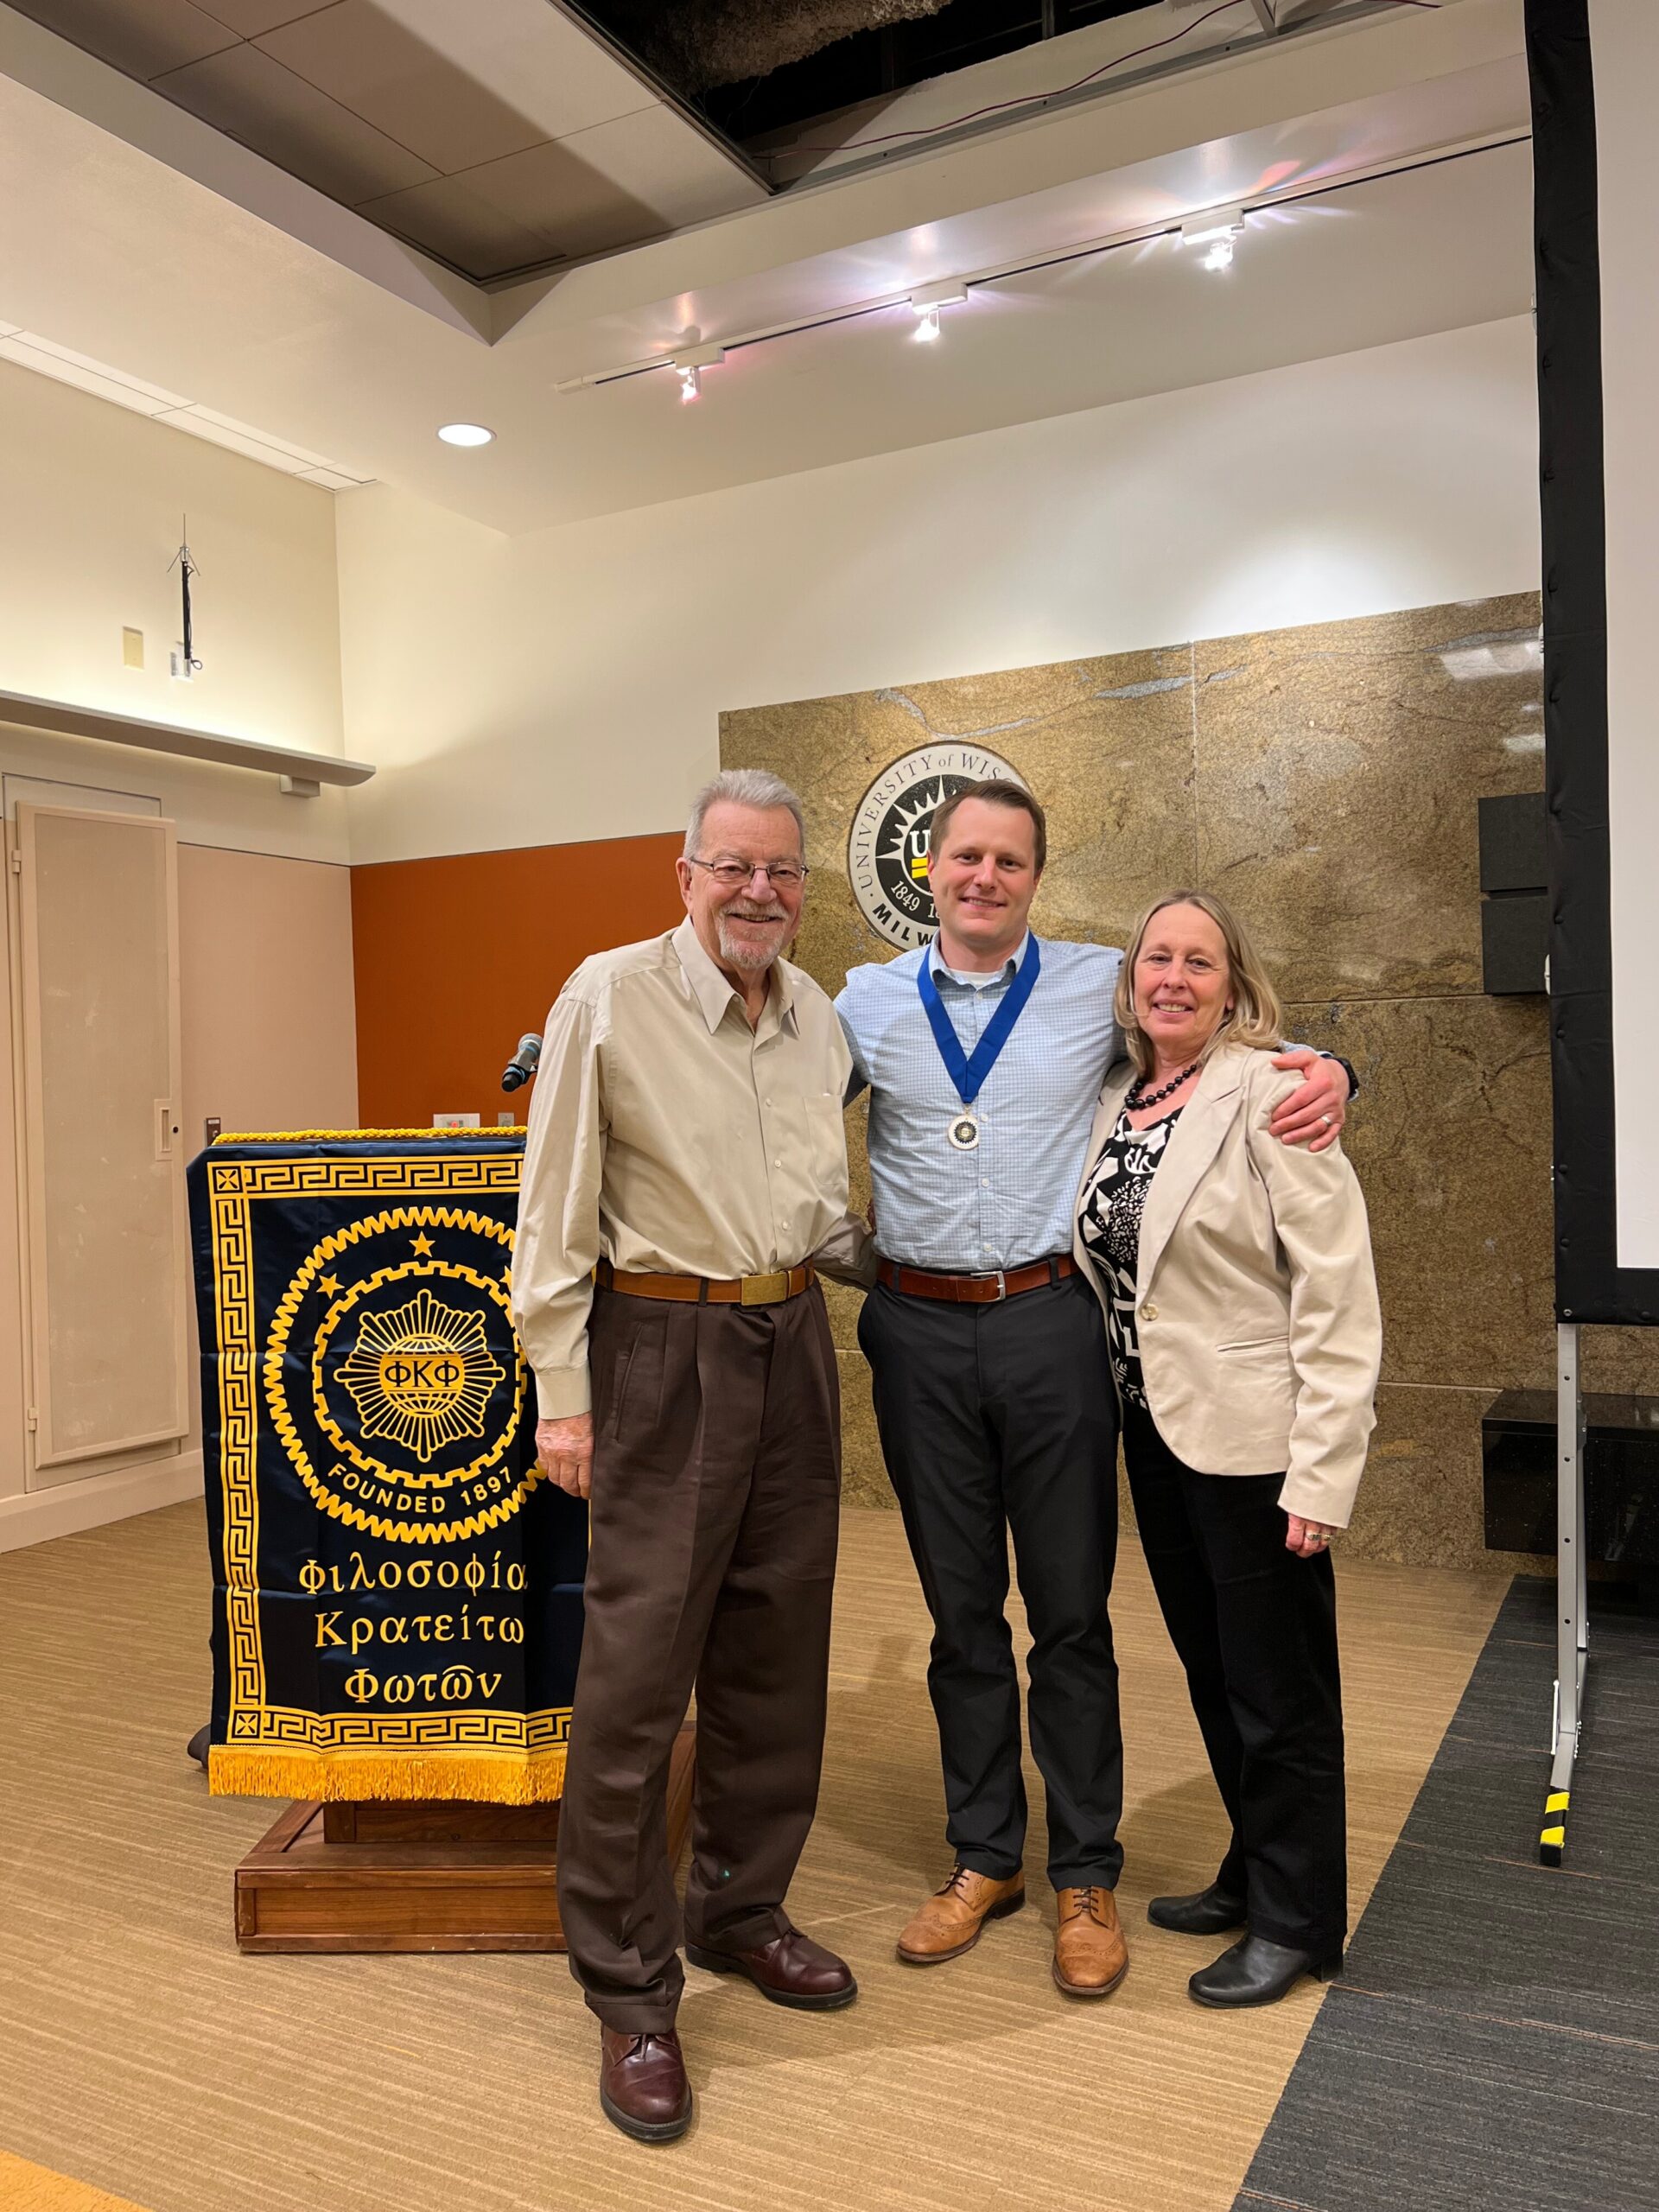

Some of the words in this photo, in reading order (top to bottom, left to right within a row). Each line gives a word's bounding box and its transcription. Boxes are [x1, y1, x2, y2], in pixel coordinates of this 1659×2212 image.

[856, 753, 932, 891] UNIVERSITY
[938, 753, 955, 767] of
[962, 753, 1013, 783] WIS
[890, 880, 921, 912] 1849
[327, 1463, 446, 1513] FOUNDED
[461, 1466, 512, 1506] 1897
